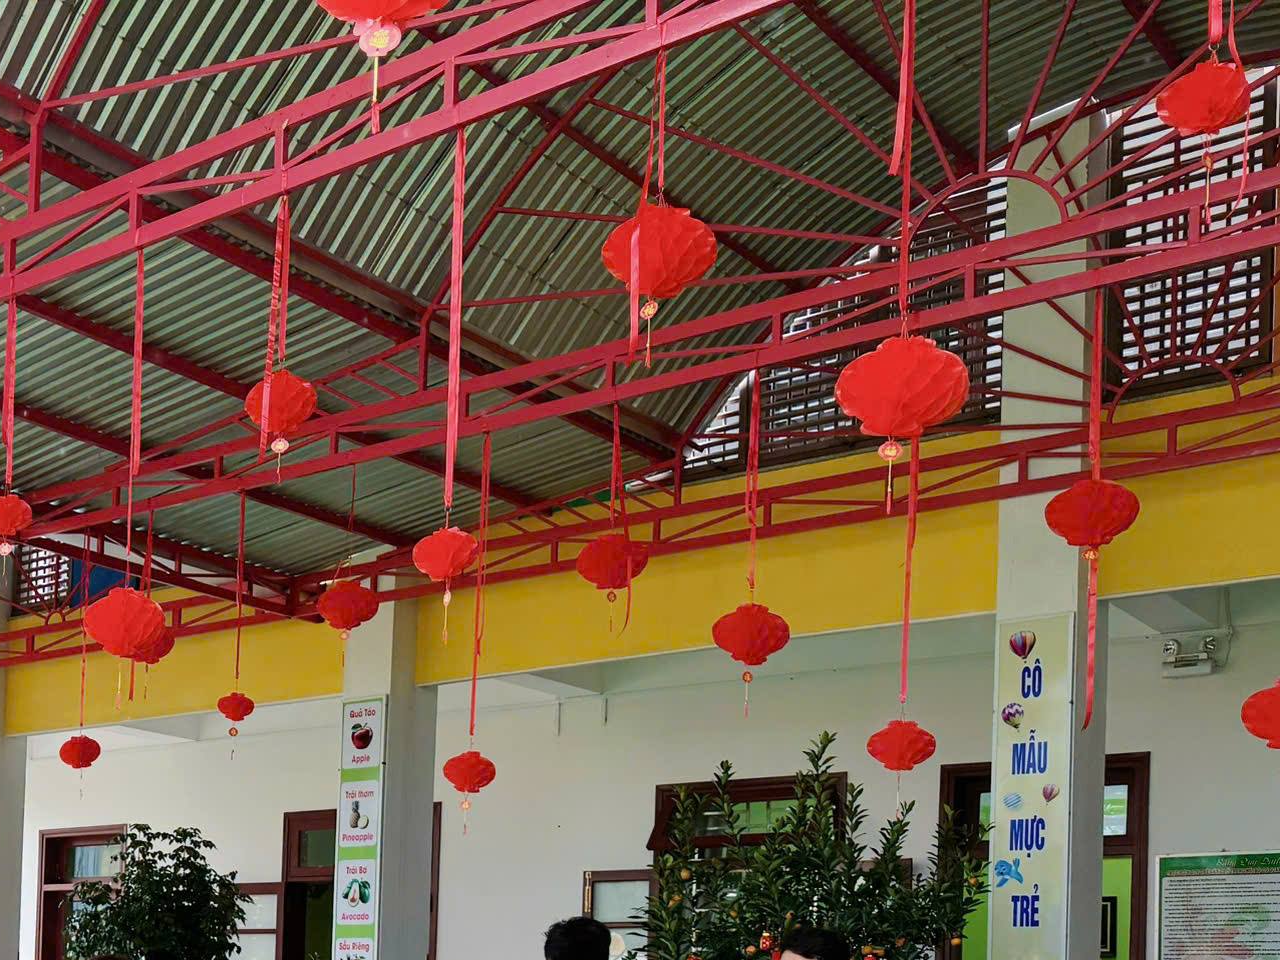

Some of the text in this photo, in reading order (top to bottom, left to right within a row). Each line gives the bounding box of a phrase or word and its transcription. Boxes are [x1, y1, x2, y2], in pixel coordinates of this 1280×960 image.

[1022, 658, 1042, 699] CÔ
[350, 708, 363, 718] Quả
[1011, 729, 1048, 775] MẪU
[351, 754, 370, 764] Apple
[342, 832, 374, 842] Pineapple
[1009, 815, 1046, 858] MỰC
[1011, 883, 1040, 928] TRẺ
[342, 912, 370, 921] Avocado
[352, 941, 370, 953] Riêng
